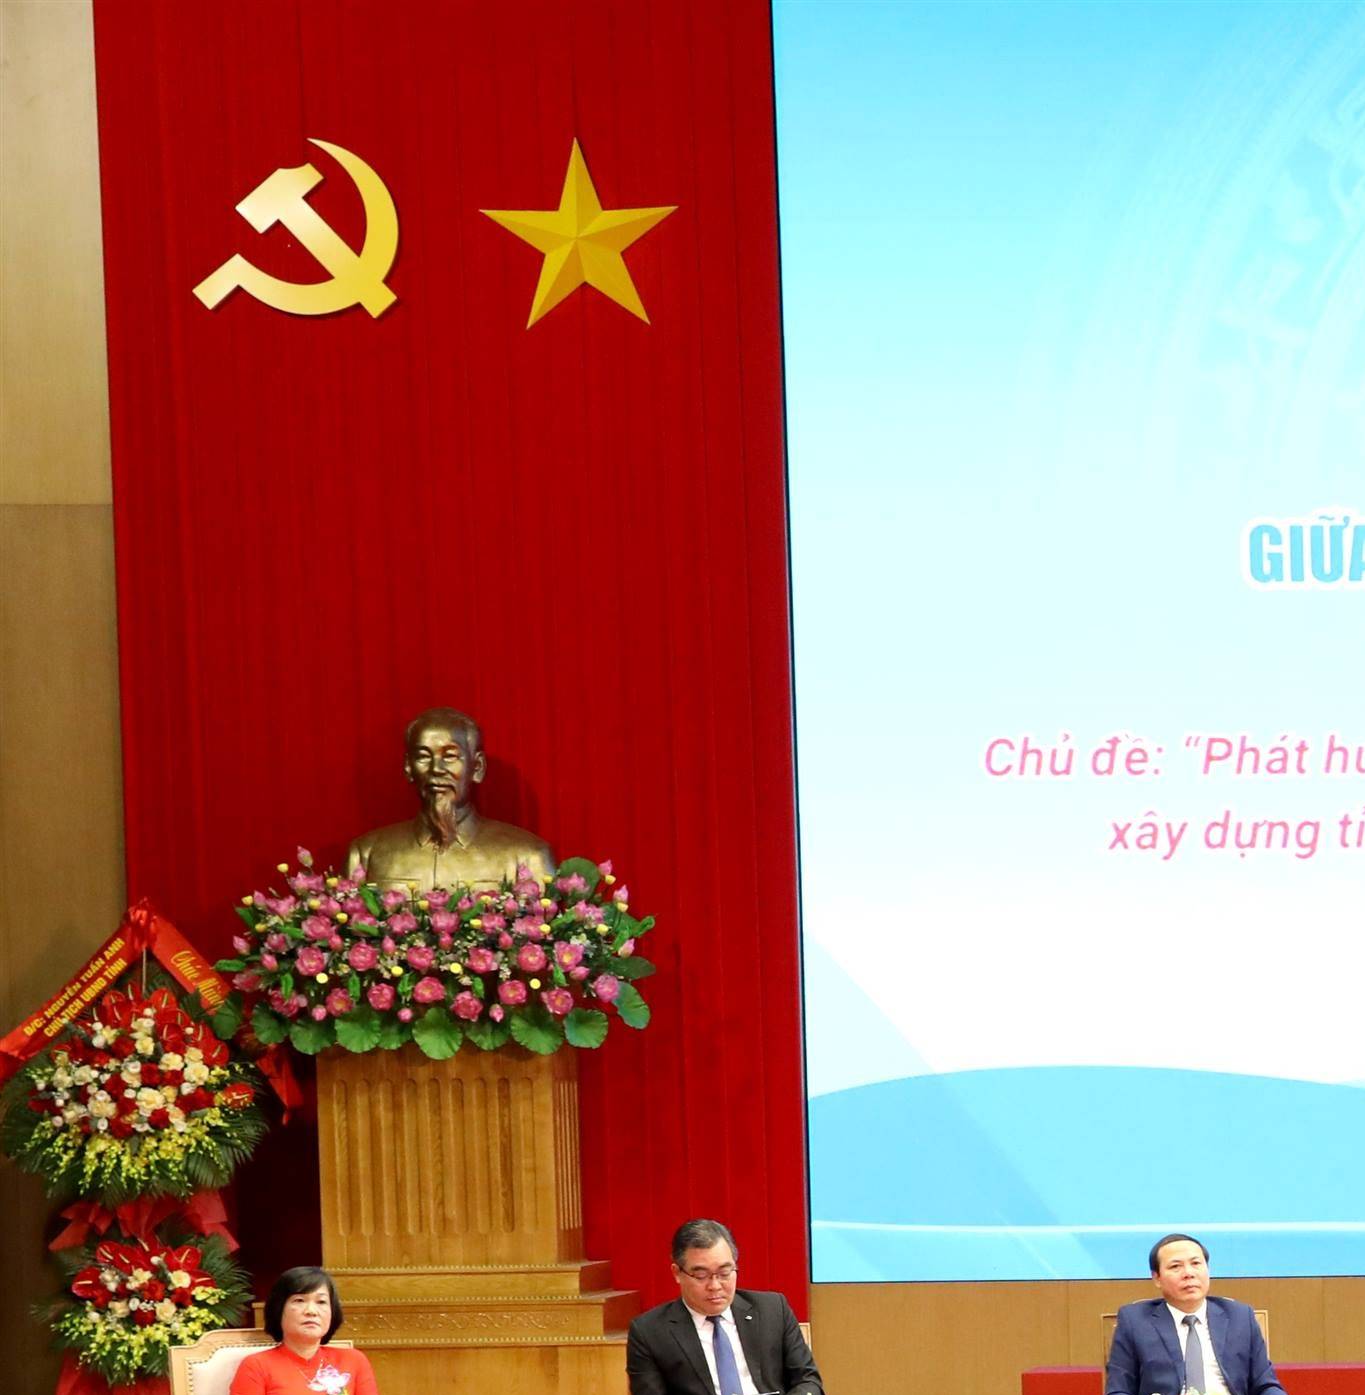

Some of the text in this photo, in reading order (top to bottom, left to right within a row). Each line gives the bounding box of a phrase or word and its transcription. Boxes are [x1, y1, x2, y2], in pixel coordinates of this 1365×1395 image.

[984, 733, 1074, 777] Chủ
[1090, 736, 1164, 776] đề:
[1109, 810, 1188, 861] xây
[1203, 809, 1321, 860] dựng
[103, 937, 125, 960] ANH
